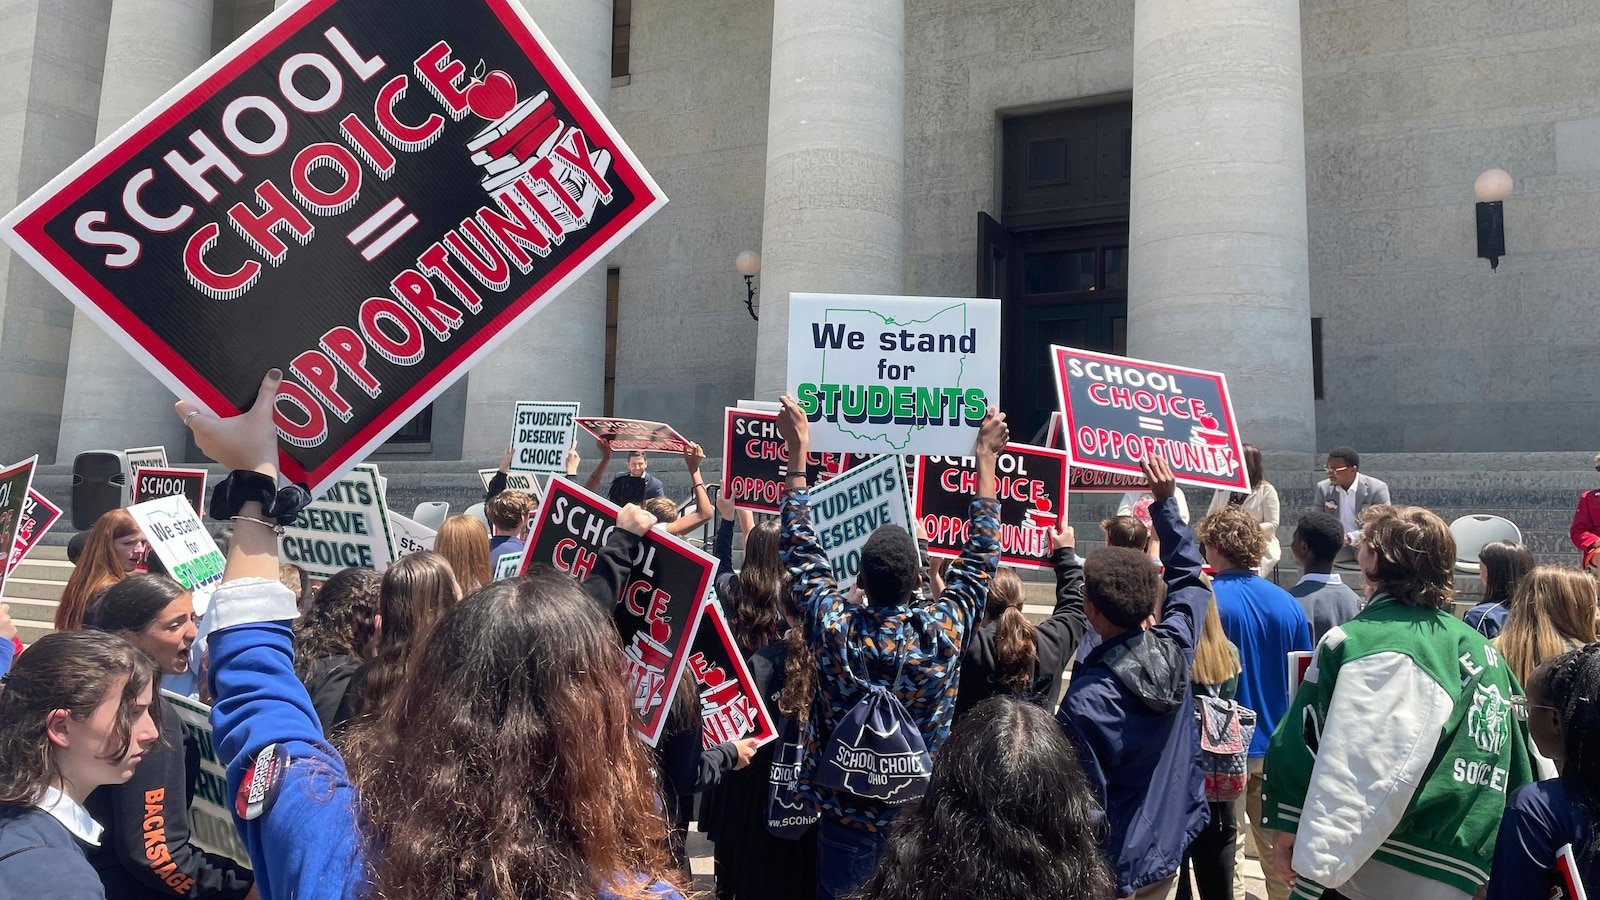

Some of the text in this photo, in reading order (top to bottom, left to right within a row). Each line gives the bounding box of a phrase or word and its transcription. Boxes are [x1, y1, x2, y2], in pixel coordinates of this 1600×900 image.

[74, 26, 386, 269] SCHOOL
[183, 40, 471, 300] CHOICE
[273, 128, 615, 448] OPPORTUNITY
[812, 323, 977, 354] We stand
[877, 359, 915, 381] for
[1068, 357, 1183, 395] SCHOOL
[797, 383, 988, 426] STUDENTS
[1088, 383, 1207, 421] CHOICE
[518, 411, 573, 427] STUDENTS
[584, 420, 648, 430] SCHOOL
[735, 418, 785, 439] SCH
[519, 429, 565, 445] DESERVE
[745, 439, 835, 466] CHOCE
[1078, 425, 1237, 478] OPPORTUNITY
[520, 448, 563, 466] CHOICE
[141, 477, 187, 495] SCHOOL
[812, 467, 897, 524] TUDENTS
[940, 468, 1046, 503] CHICE
[149, 515, 200, 542] We stand
[287, 508, 368, 536] SERVE
[820, 501, 892, 550] ESERVE
[184, 540, 200, 555] for
[282, 535, 375, 569] CHOICE
[400, 537, 428, 552] sta
[552, 538, 671, 623] CHCE
[836, 745, 877, 772] SCHOOL
[250, 757, 264, 801] CHOICE
[867, 772, 888, 786] OHIO
[142, 787, 196, 895] BACKSTAGE
